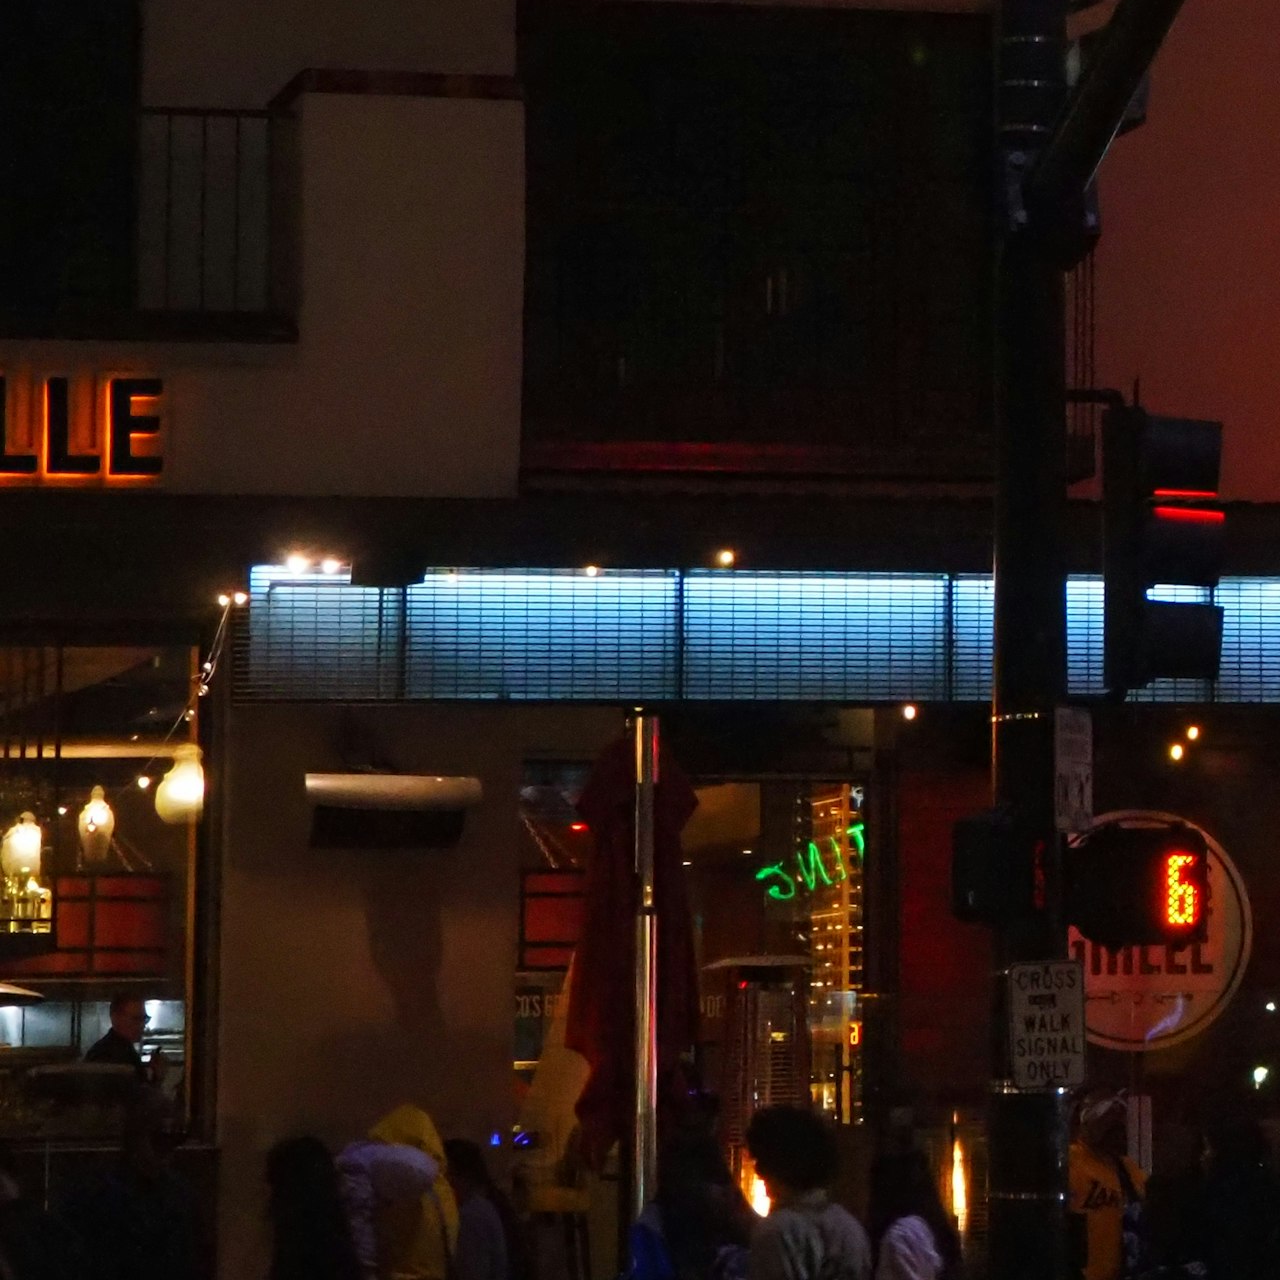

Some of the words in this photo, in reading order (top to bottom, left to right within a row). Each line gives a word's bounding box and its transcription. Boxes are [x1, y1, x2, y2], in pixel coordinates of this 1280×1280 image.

[0, 377, 163, 474] LLE
[1167, 854, 1195, 925] 6
[1017, 969, 1076, 991] CROSS
[1024, 1013, 1070, 1032] WALK
[1016, 1037, 1081, 1057] SIGNAL
[1027, 1061, 1070, 1079] ONLY
